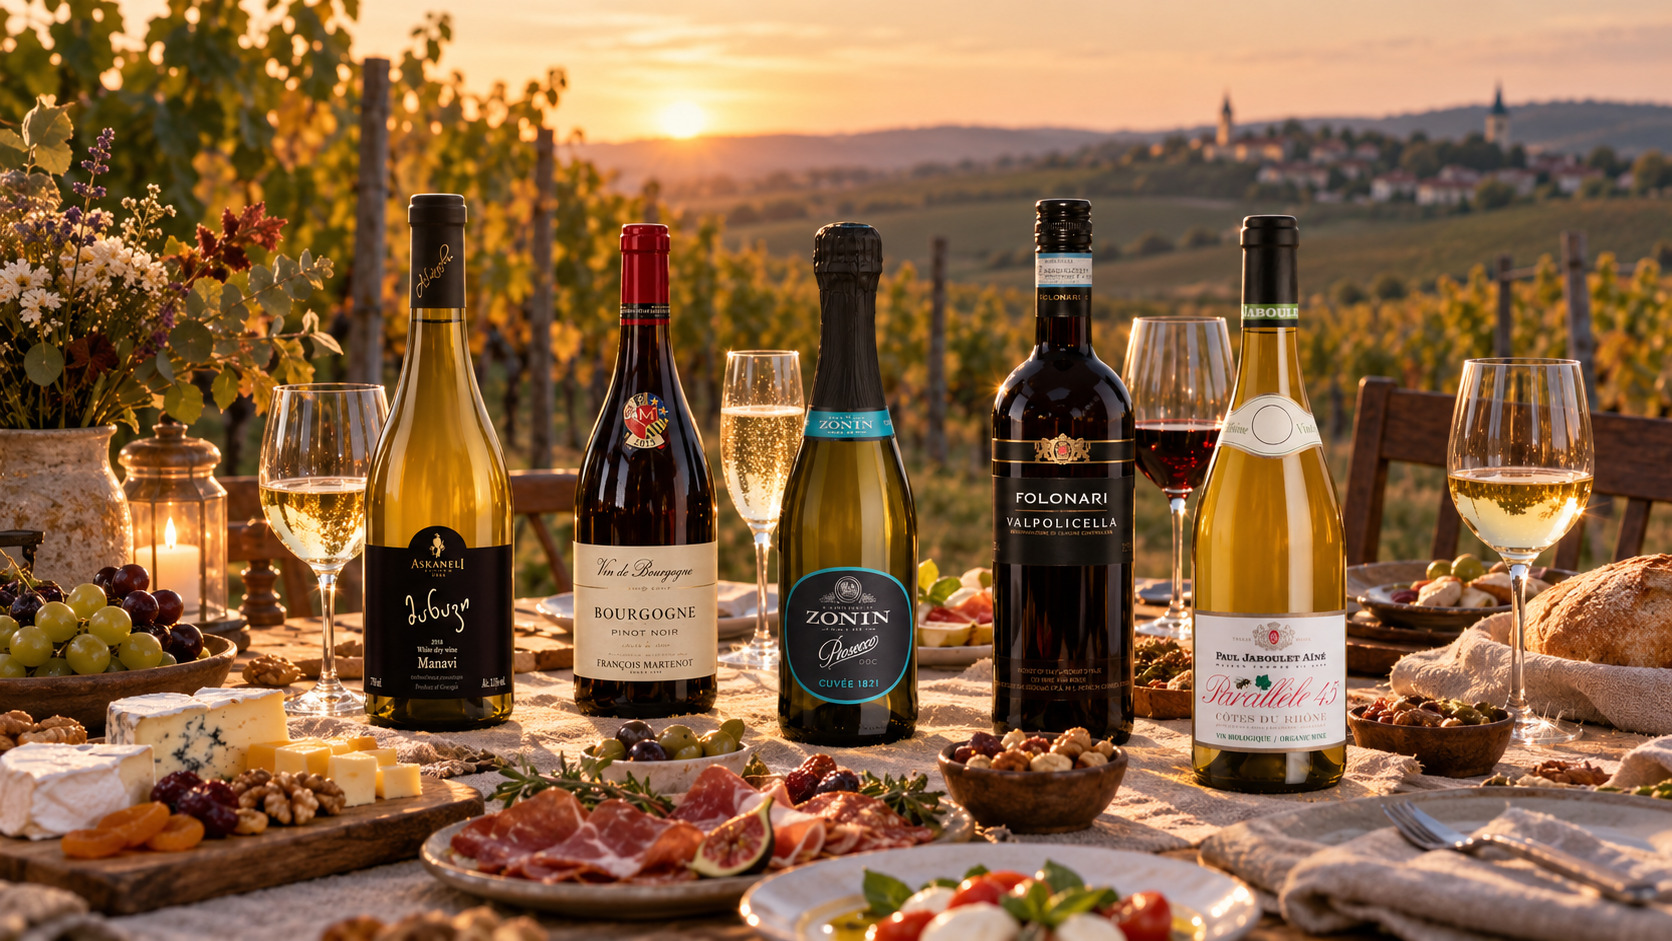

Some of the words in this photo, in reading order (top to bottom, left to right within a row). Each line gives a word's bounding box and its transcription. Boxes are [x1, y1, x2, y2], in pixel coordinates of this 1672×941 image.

[819, 420, 873, 430] ZONIN
[1016, 492, 1107, 505] FOLONARI
[1007, 517, 1117, 529] VALPOLICELLA
[411, 558, 464, 570] ASKANELI
[597, 557, 617, 576] Vin
[617, 563, 629, 577] de
[631, 558, 693, 583] Bourgogne
[594, 606, 696, 621] BOURGOGNE
[806, 610, 890, 625] ZONIN
[611, 629, 646, 637] PINOT
[818, 634, 879, 670] Prosecco
[1216, 651, 1239, 662] PAUL
[1242, 653, 1300, 663] JABOULET
[417, 656, 457, 669] Manavi
[596, 658, 641, 671] FRANÇOIS
[643, 658, 693, 669] MARTENOT
[818, 678, 854, 688] CUVÉE
[858, 679, 879, 688] 1821
[1202, 674, 1313, 709] Parallèle
[1314, 680, 1340, 706] 45
[1215, 711, 1255, 723] CÔTES
[1260, 715, 1279, 724] DU
[1284, 712, 1327, 723] RHÔNE
